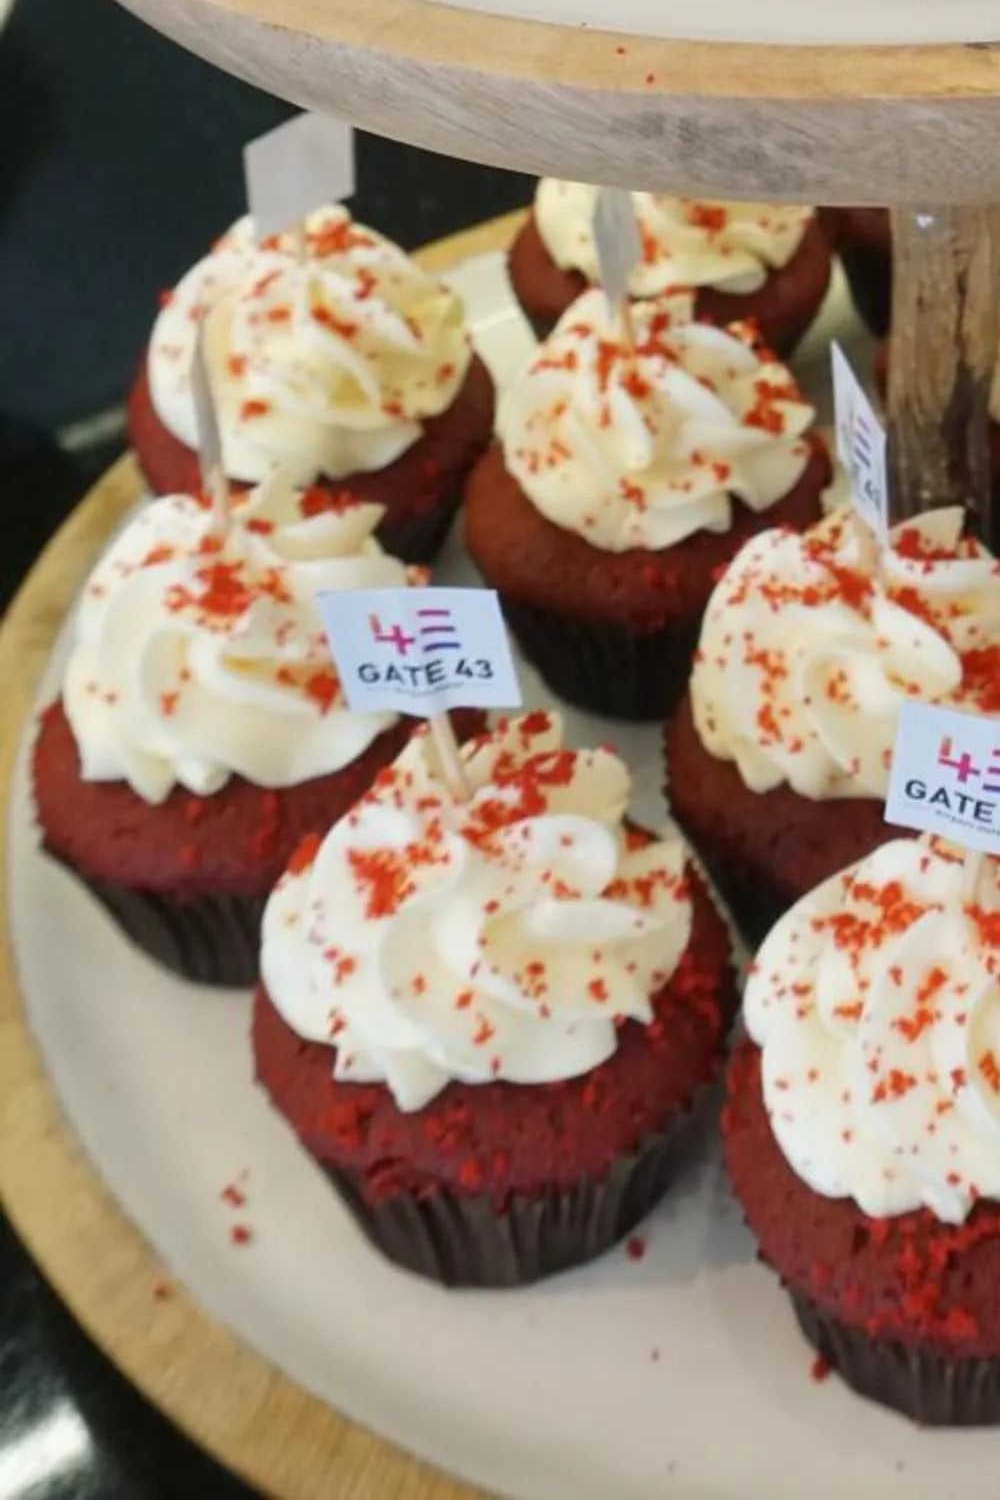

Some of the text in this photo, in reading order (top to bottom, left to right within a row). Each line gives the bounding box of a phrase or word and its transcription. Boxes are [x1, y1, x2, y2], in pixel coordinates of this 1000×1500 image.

[356, 658, 494, 688] GATE 43
[904, 778, 996, 825] GATE
